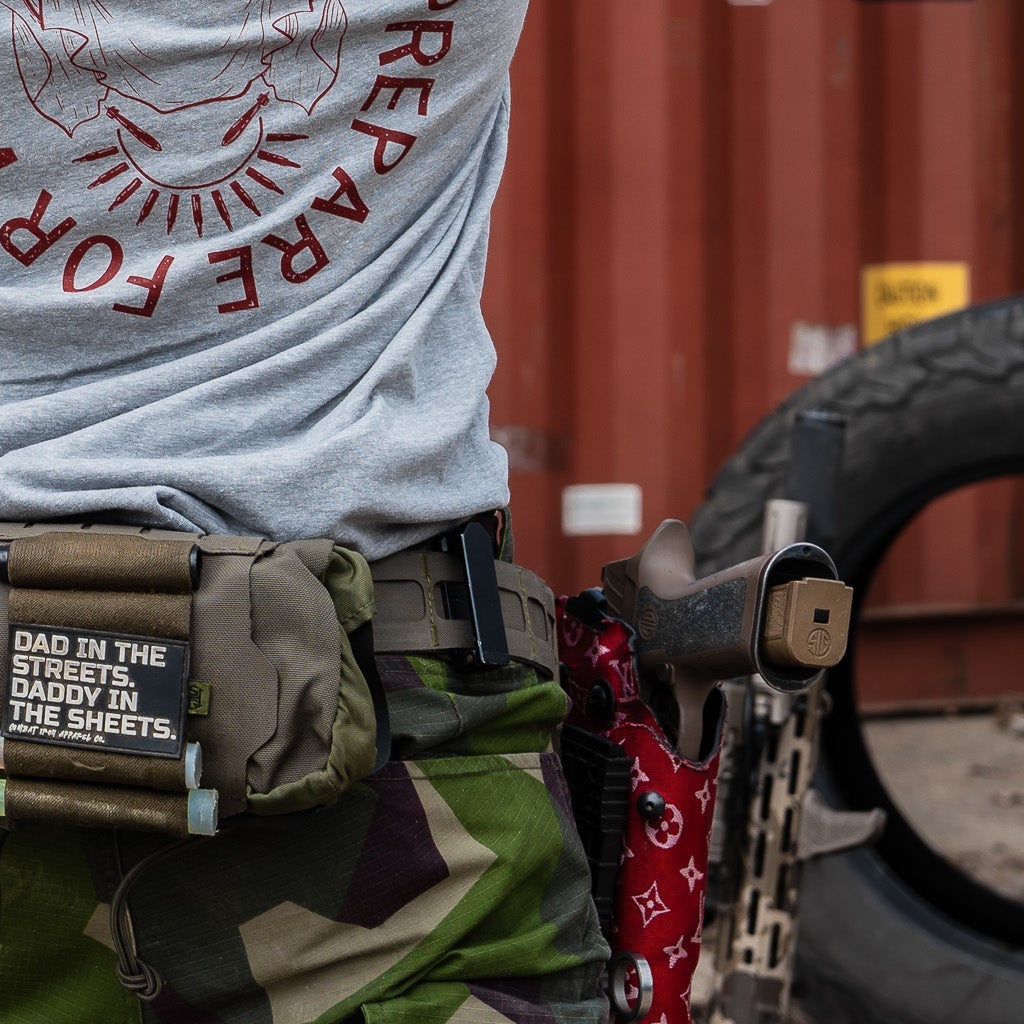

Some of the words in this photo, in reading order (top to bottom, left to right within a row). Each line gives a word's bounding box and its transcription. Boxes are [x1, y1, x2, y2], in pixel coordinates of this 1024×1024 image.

[13, 630, 70, 656] DAD
[76, 637, 107, 661] IN
[114, 640, 167, 668] THE
[12, 655, 135, 688] STREETS.
[11, 677, 102, 707] DADDY
[108, 689, 139, 712] IN
[9, 700, 60, 727] THE
[67, 709, 177, 740] SHEETS.
